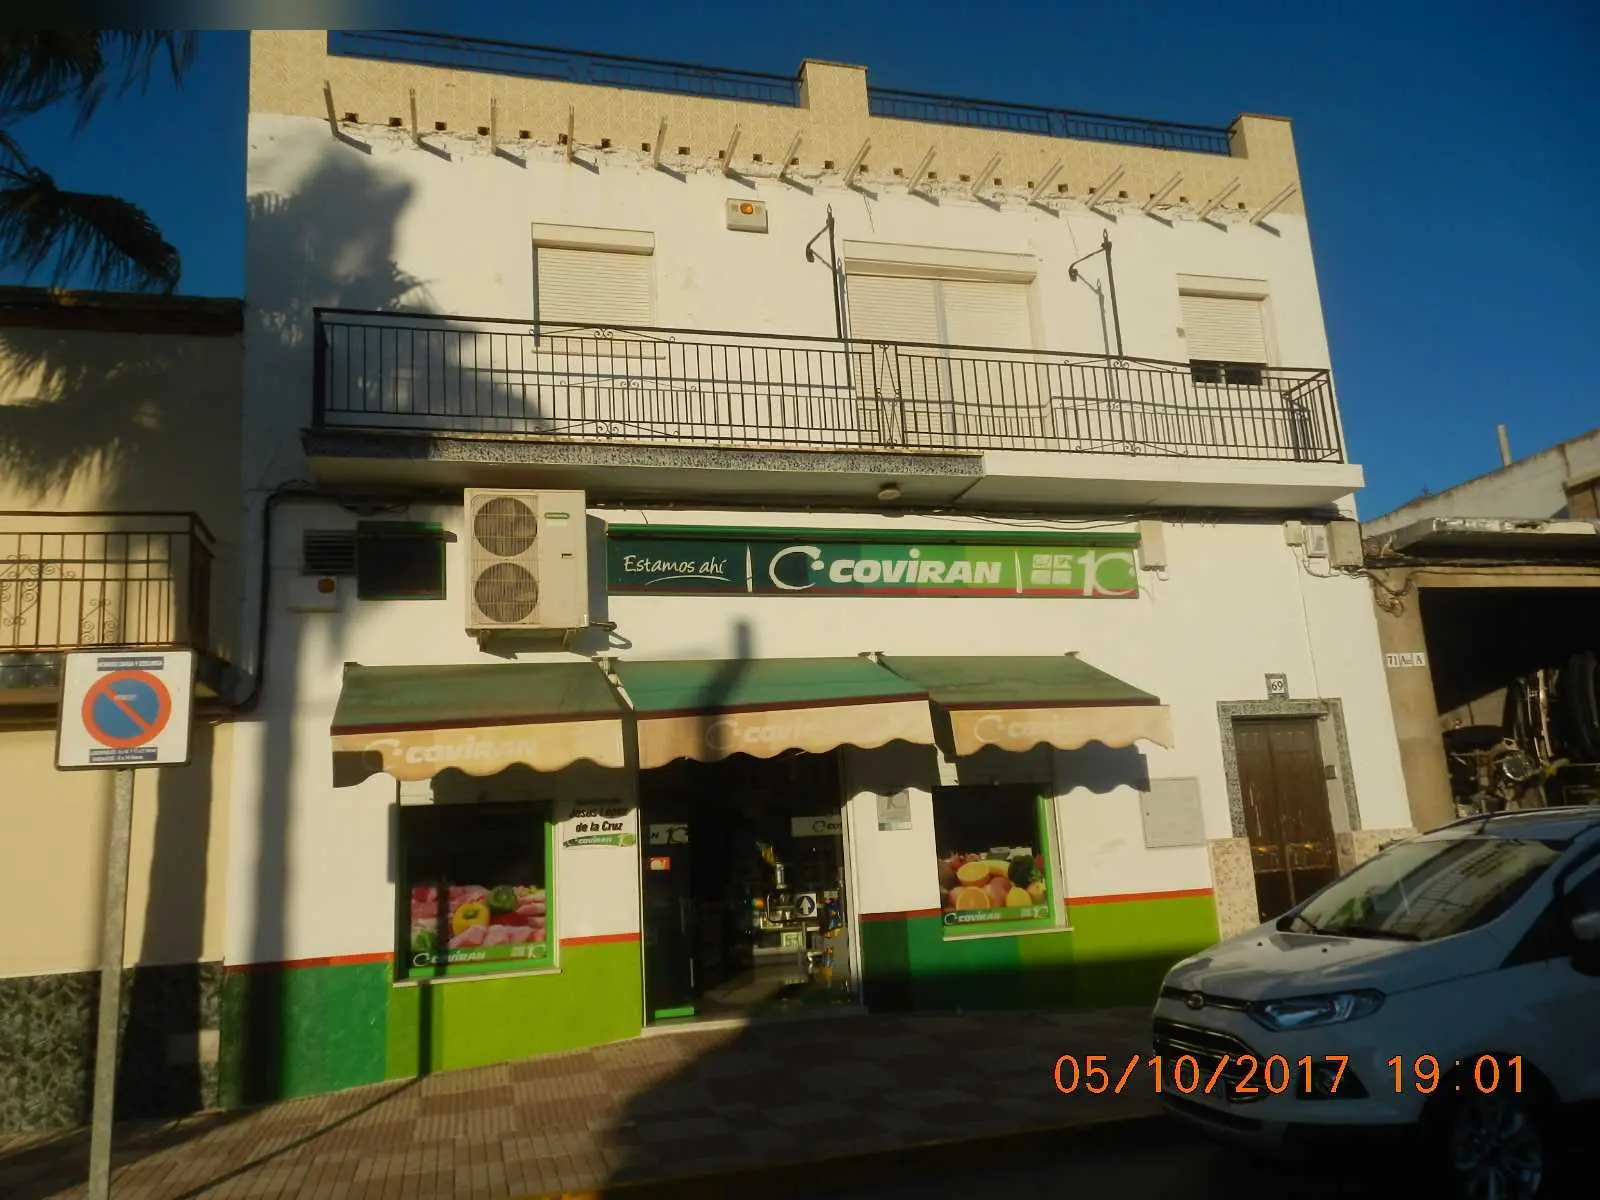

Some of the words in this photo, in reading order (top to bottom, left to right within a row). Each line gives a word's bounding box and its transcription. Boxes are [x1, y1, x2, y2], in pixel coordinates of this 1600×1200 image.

[623, 555, 696, 574] Estamos
[699, 557, 728, 575] ahí
[1271, 680, 1283, 691] 69
[575, 822, 588, 833] de
[590, 821, 600, 832] la
[602, 820, 623, 832] Cruz
